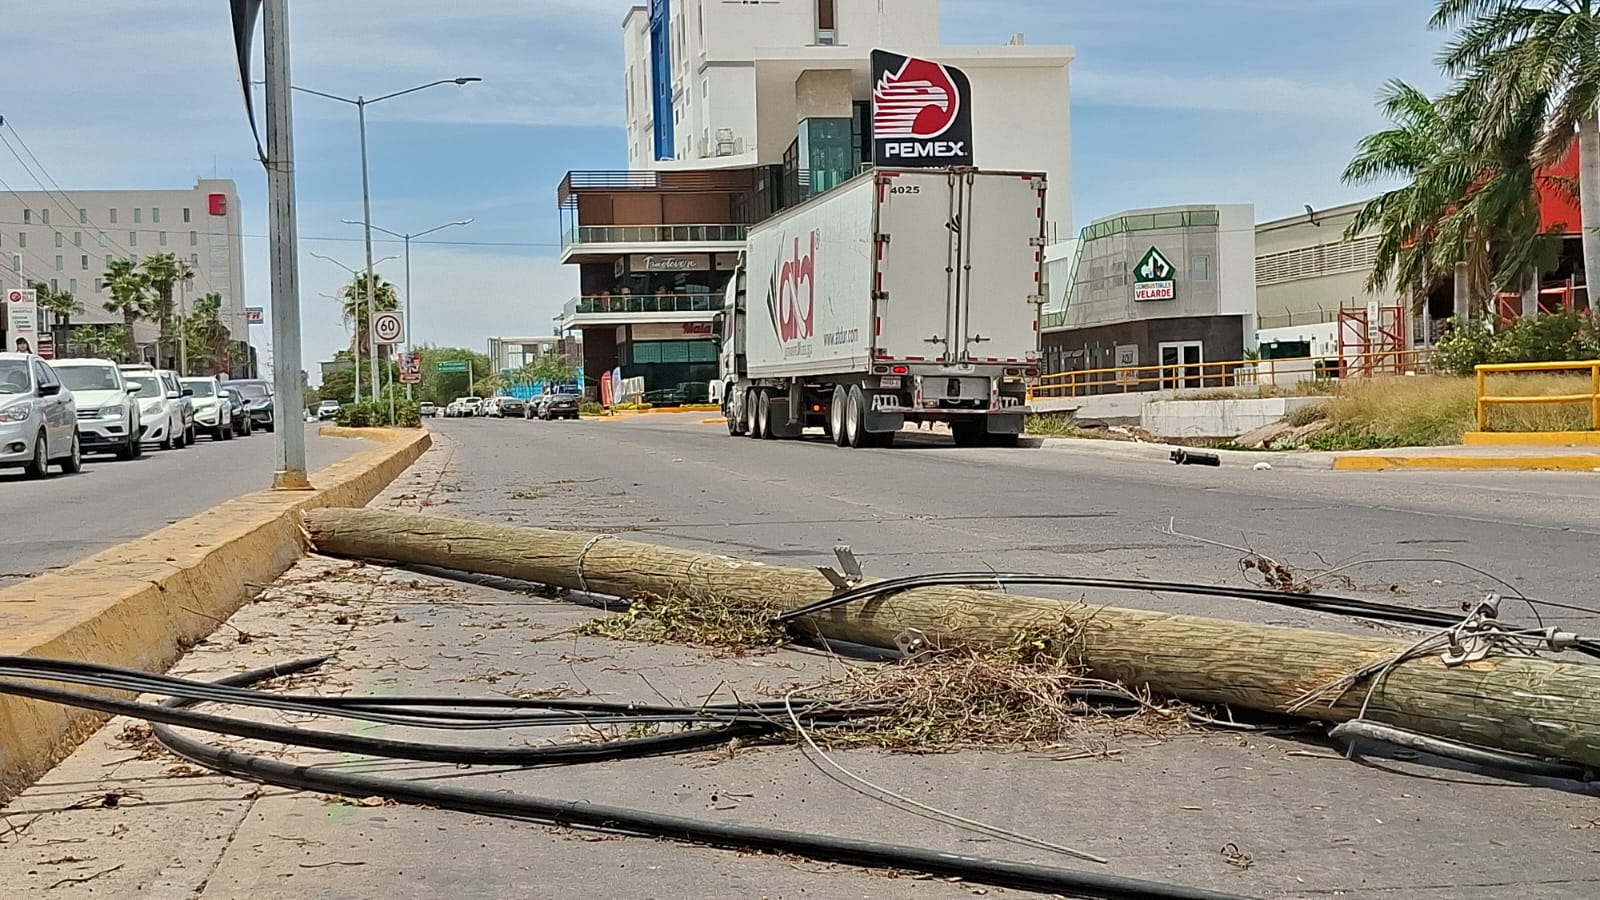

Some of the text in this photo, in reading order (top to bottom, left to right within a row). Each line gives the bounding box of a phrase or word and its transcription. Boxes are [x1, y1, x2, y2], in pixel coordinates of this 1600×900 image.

[885, 141, 965, 158] PEMEX
[890, 185, 920, 194] 4025
[1135, 288, 1172, 299] VELARDE
[380, 319, 395, 332] 60
[871, 394, 900, 411] ATD
